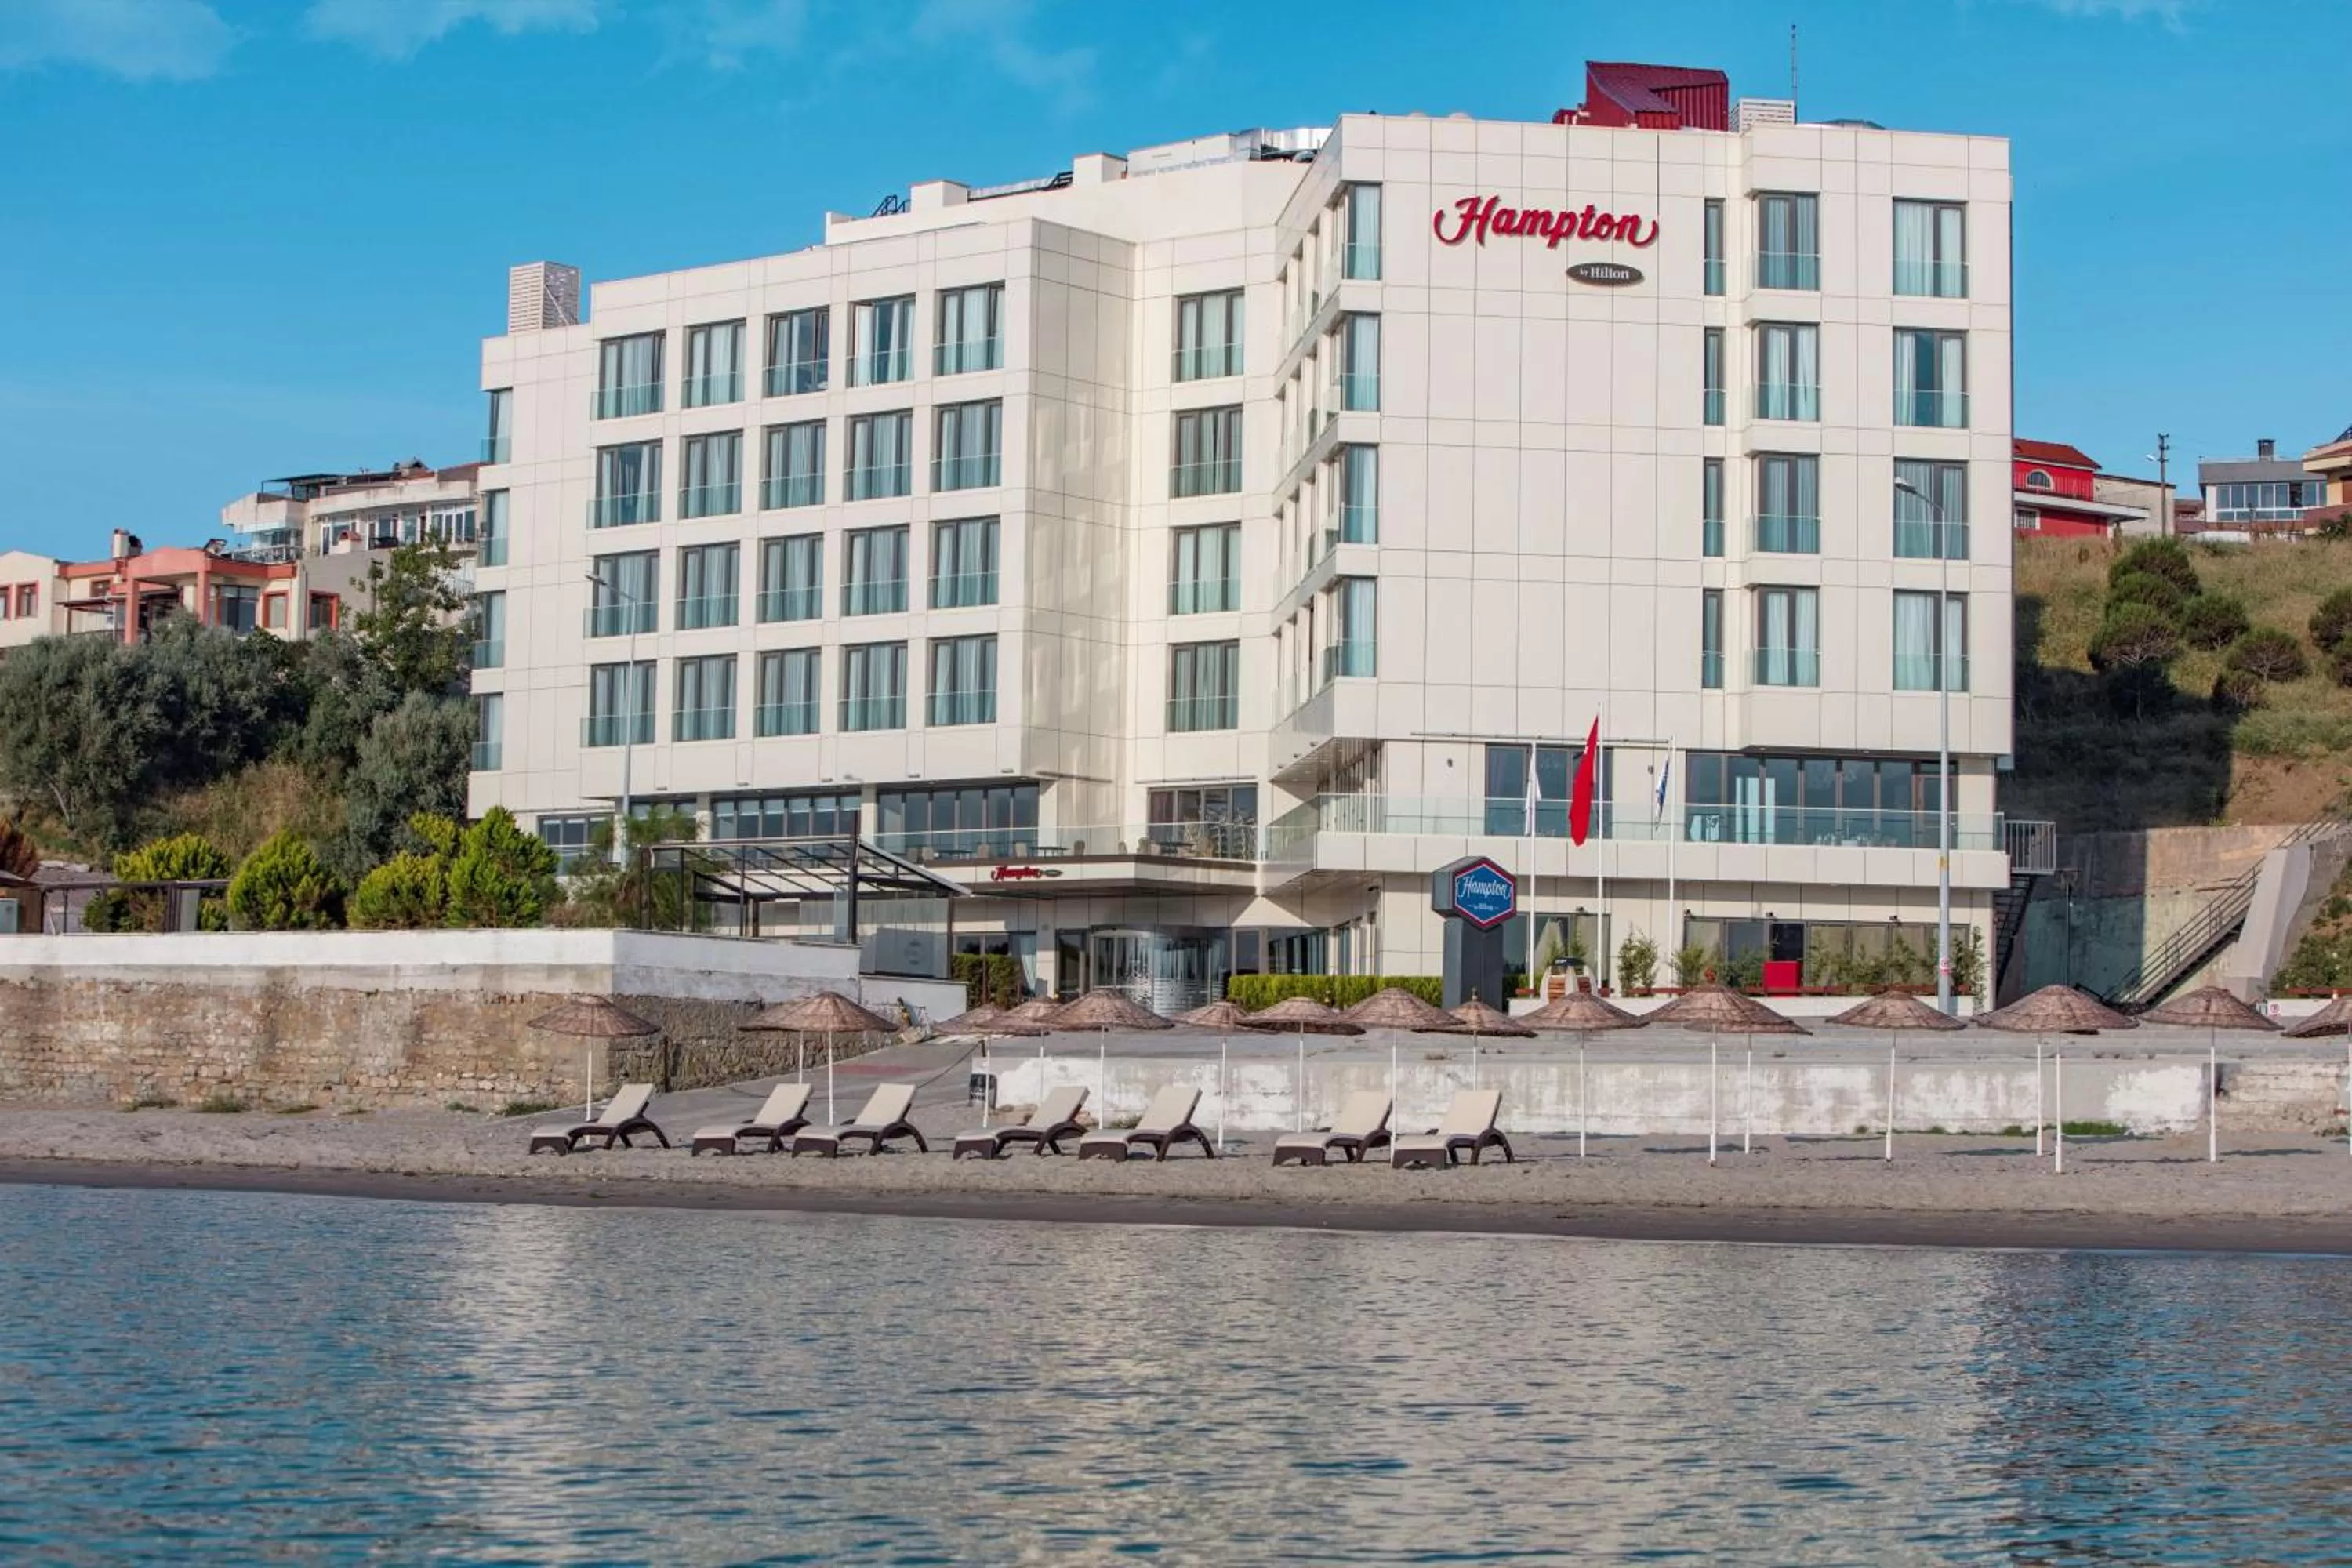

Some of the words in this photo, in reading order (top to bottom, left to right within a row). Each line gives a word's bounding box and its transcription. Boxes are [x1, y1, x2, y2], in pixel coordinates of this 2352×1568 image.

[1434, 195, 1658, 249] Hampton
[1591, 267, 1630, 279] Hilton
[1457, 875, 1511, 900] Hampton
